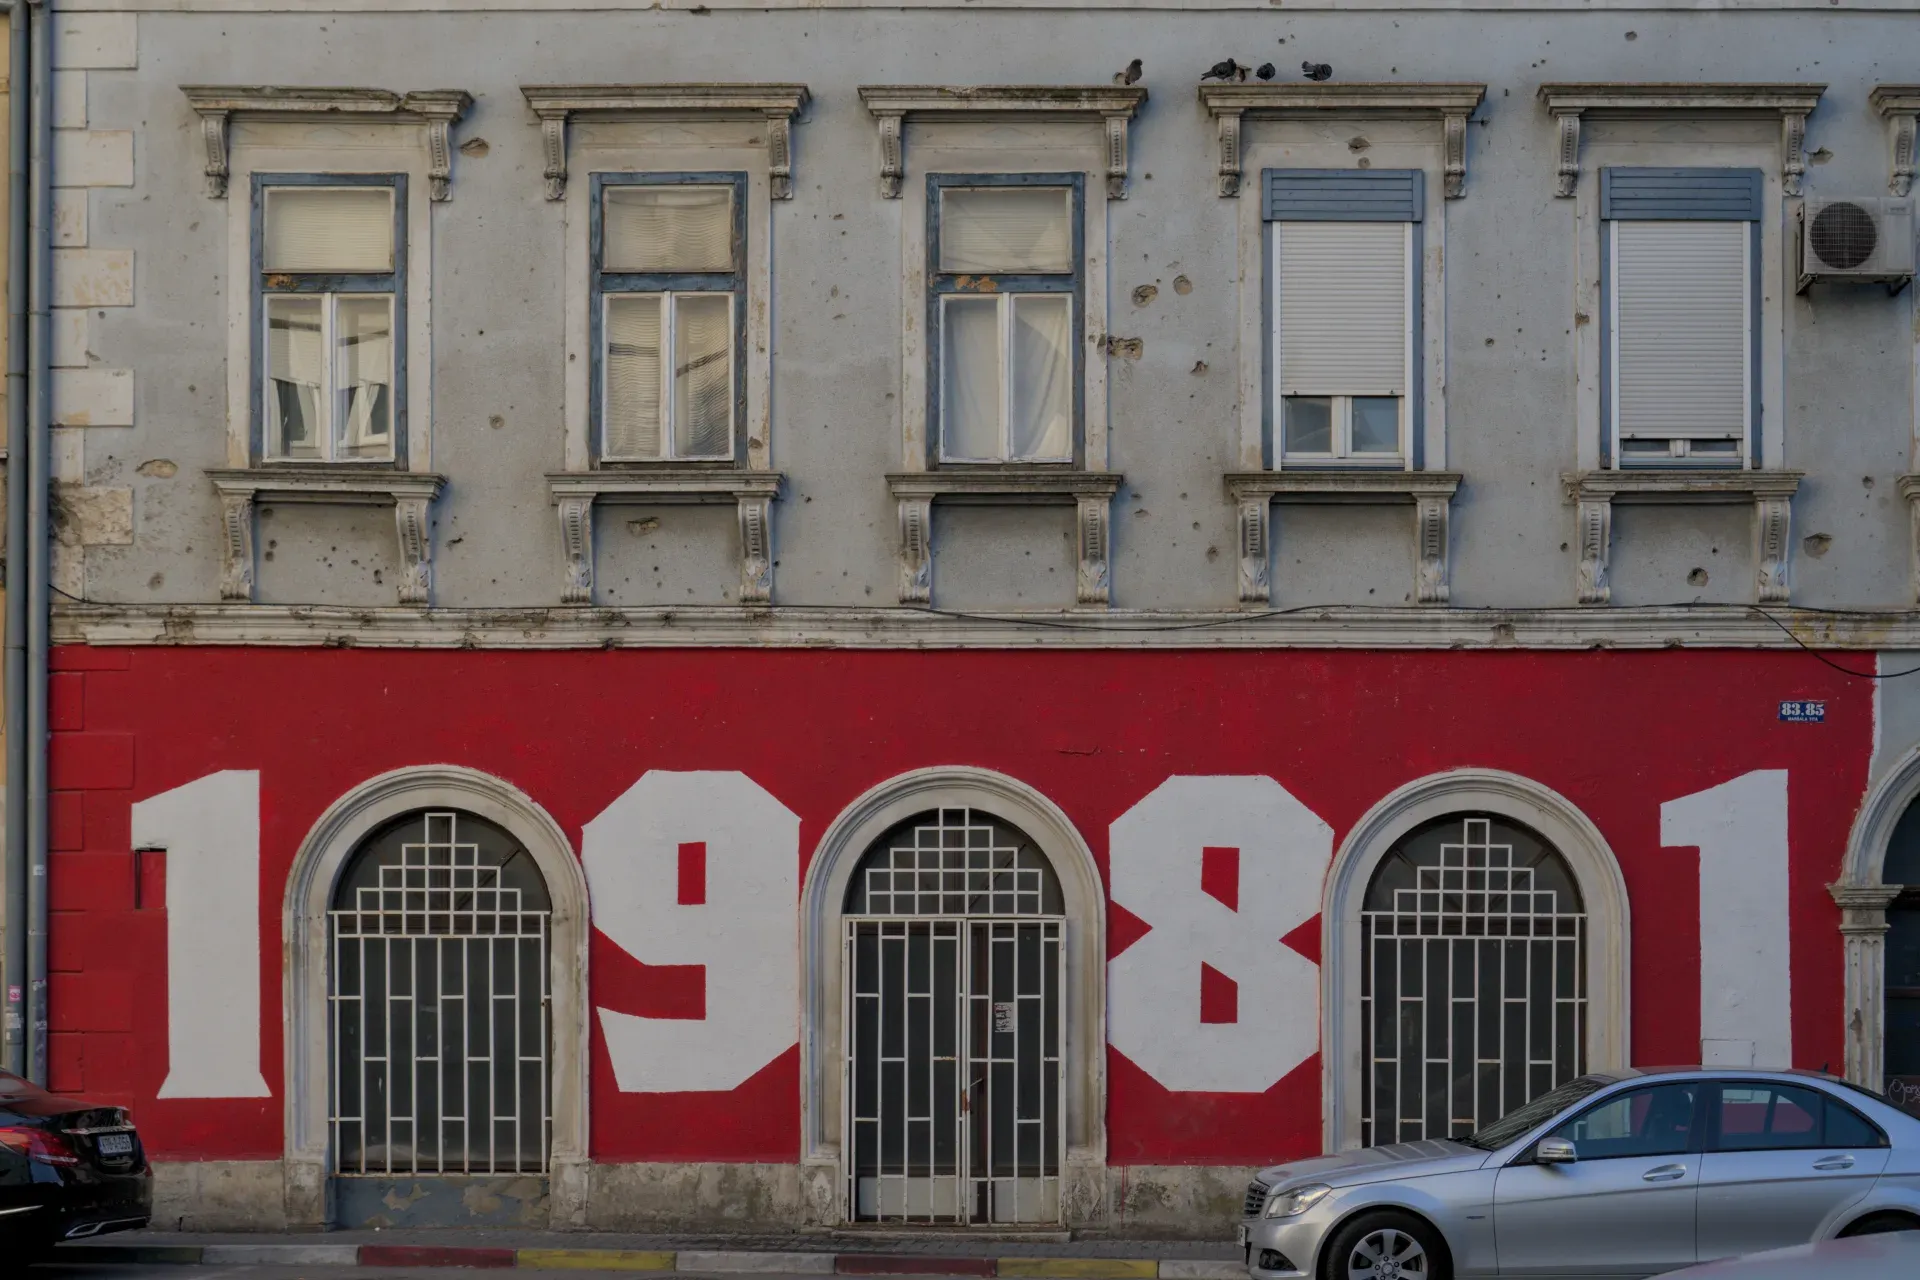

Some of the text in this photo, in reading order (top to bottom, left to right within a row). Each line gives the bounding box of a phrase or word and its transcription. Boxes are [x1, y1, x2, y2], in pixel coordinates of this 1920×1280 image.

[130, 769, 272, 1100] 1
[580, 769, 803, 1093] 9
[1107, 774, 1336, 1093] 8
